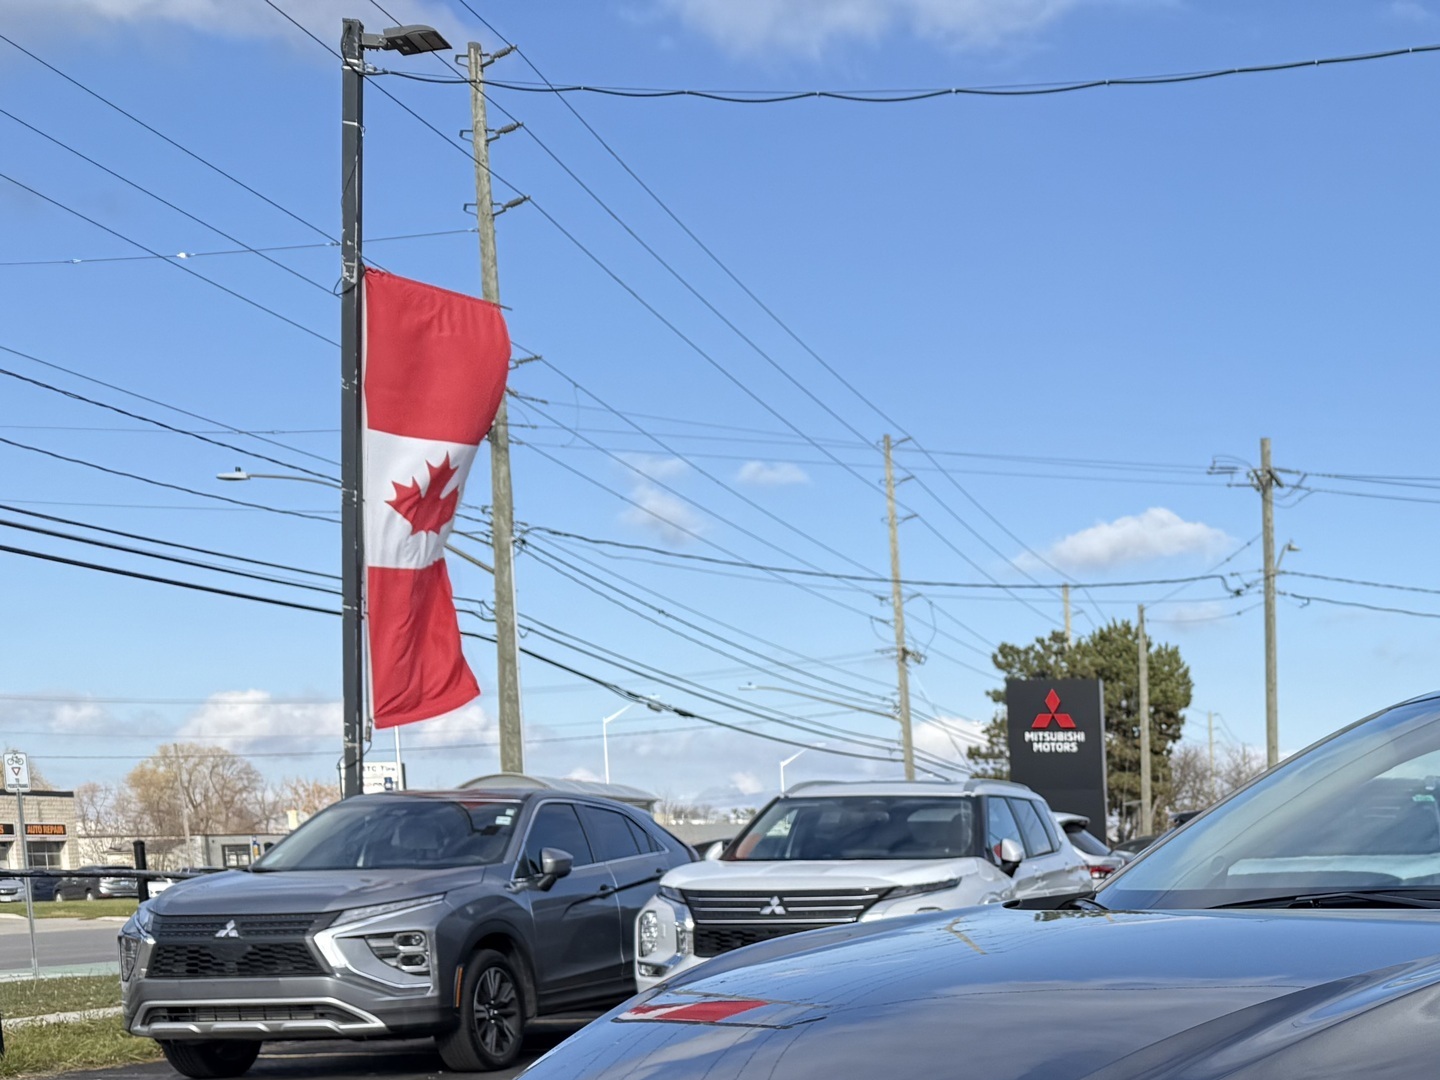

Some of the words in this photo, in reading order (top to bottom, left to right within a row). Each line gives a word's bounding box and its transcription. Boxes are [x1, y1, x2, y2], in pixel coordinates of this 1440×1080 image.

[1024, 731, 1085, 742] MITSUBISHI
[1033, 742, 1078, 752] MOTORS
[28, 825, 43, 834] AUTO
